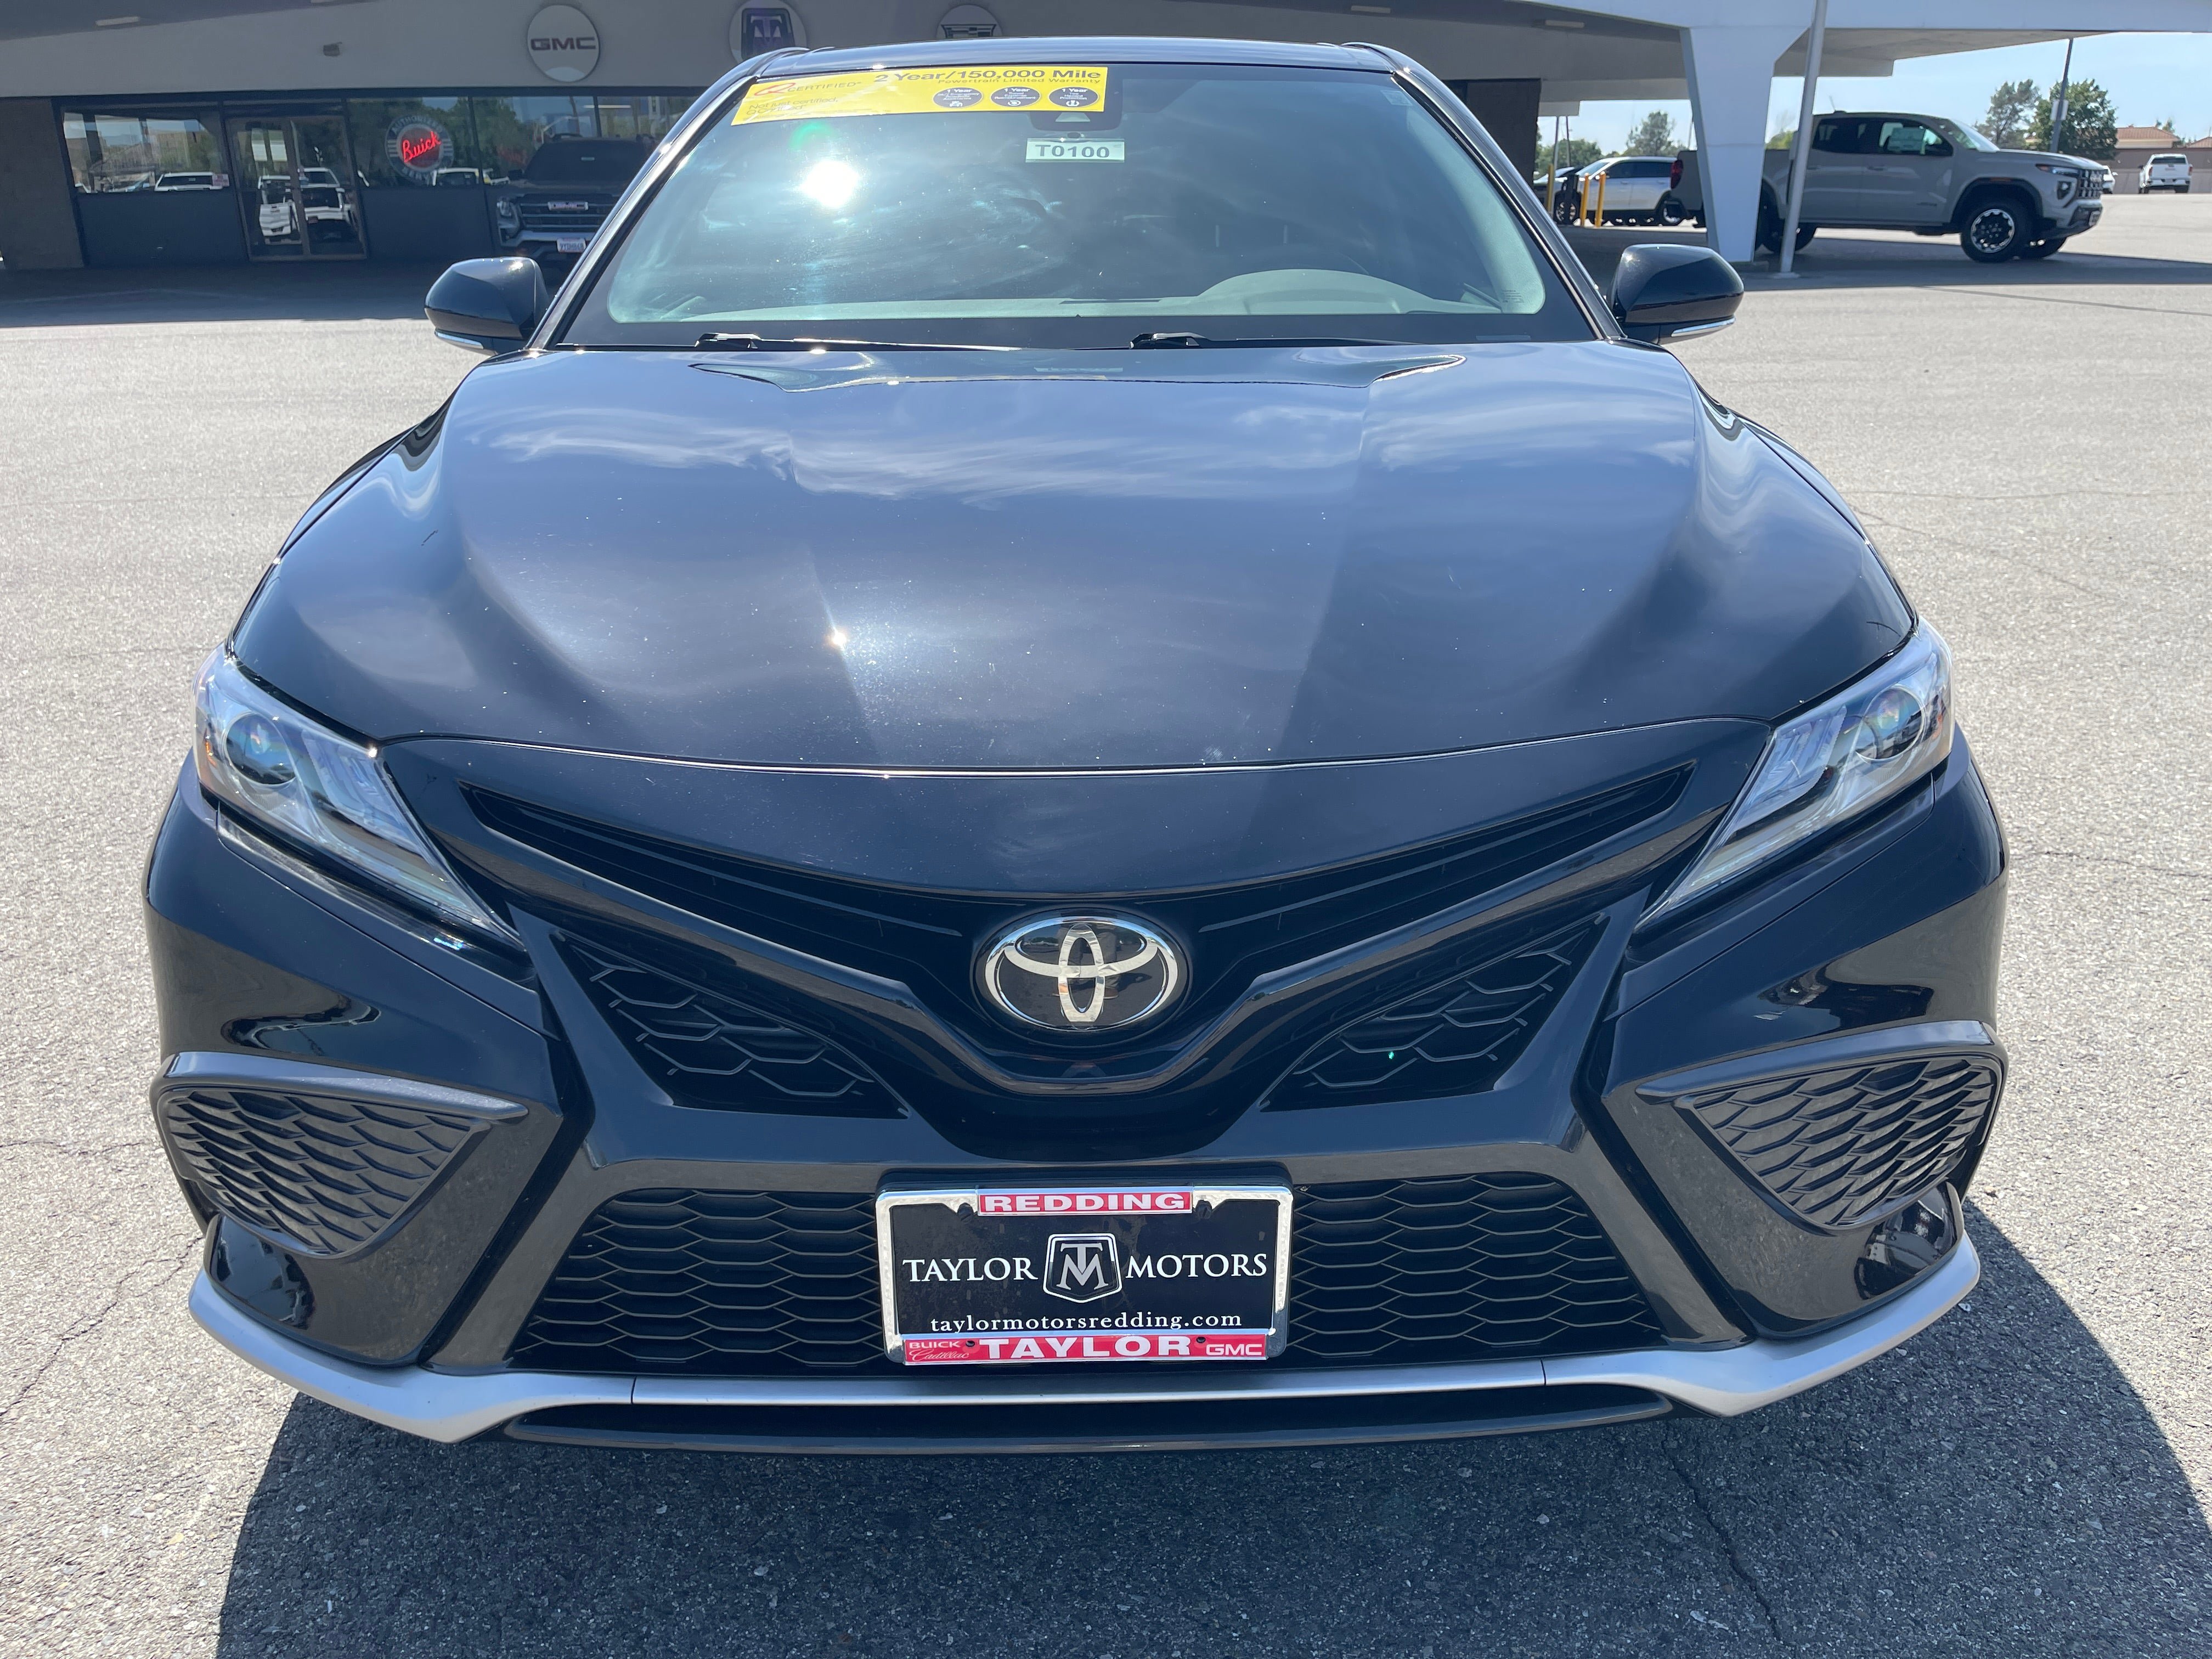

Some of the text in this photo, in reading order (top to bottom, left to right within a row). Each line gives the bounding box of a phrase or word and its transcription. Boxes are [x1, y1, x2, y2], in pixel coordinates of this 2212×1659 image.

[531, 37, 596, 50] GMC
[894, 70, 1045, 81] Year/150,000
[1052, 70, 1101, 78] Mile
[402, 131, 442, 163] Buick
[1035, 144, 1110, 158] T0100
[985, 1193, 1185, 1212] REDDING
[902, 1253, 1268, 1283] TAYLOR MOTORS
[930, 1312, 1243, 1334] taylormotorsredding.com
[909, 1341, 961, 1349] BUICK
[979, 1335, 1192, 1359] TAYLOR
[1206, 1344, 1262, 1356] GMC
[909, 1348, 970, 1362] Cadillac
